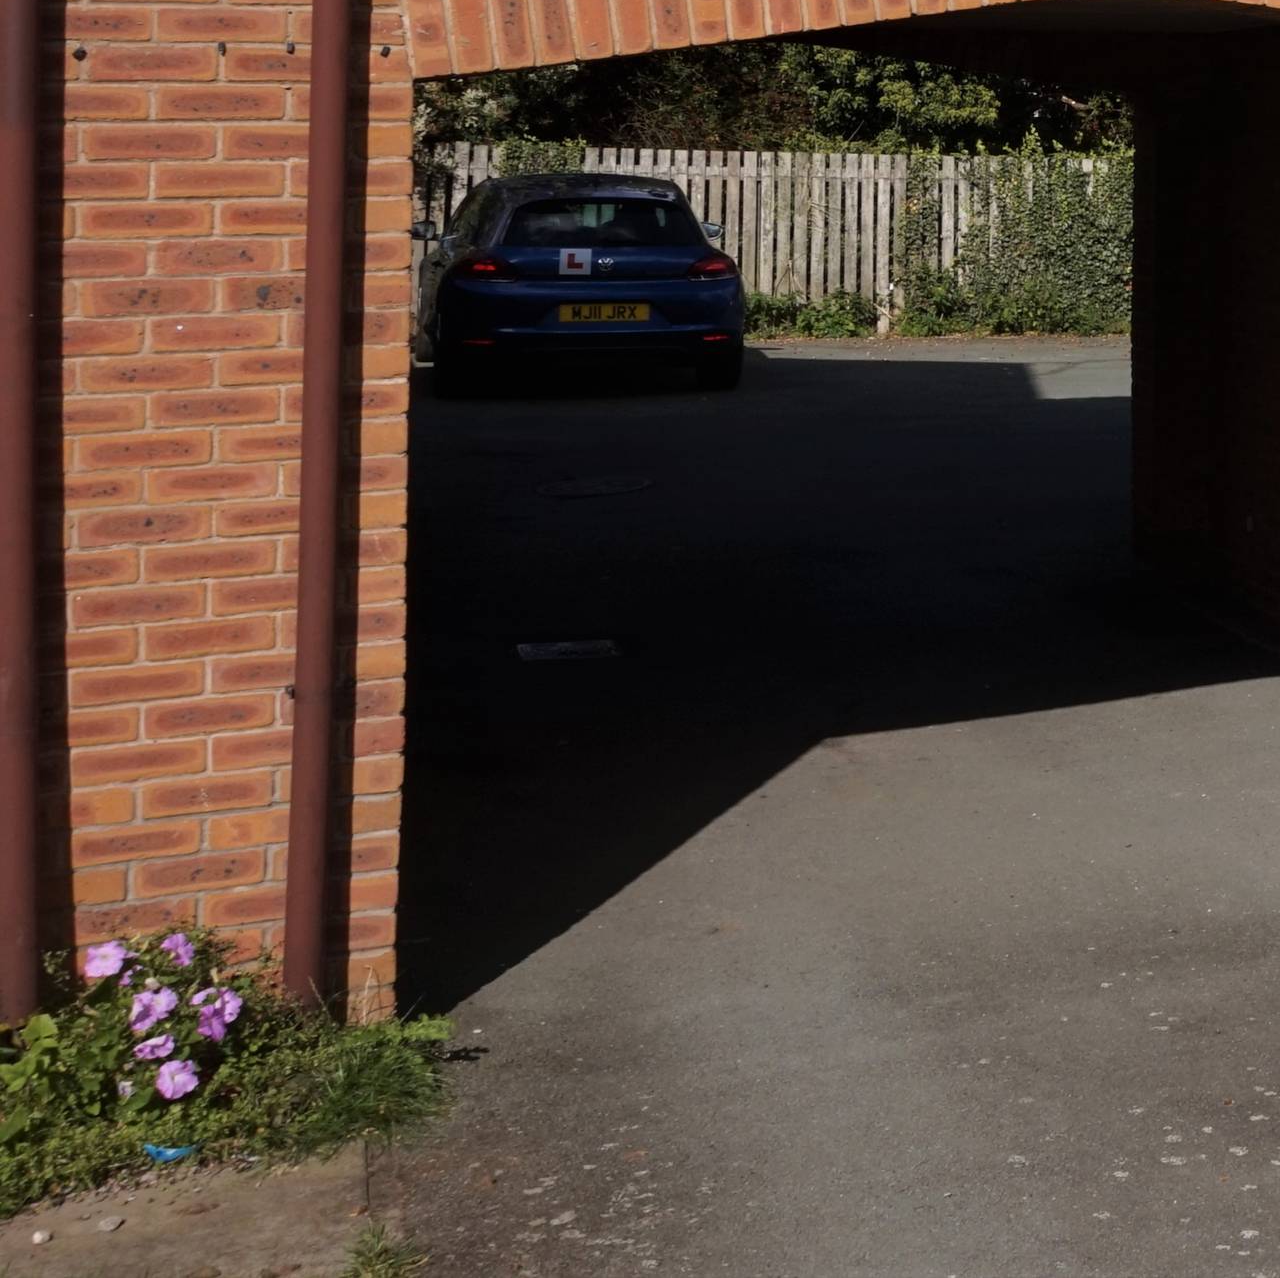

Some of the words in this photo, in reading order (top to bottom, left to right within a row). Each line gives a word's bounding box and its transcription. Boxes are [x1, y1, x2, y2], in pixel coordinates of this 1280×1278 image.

[567, 253, 583, 269] L
[572, 305, 601, 320] MJ11
[606, 305, 637, 320] JRX
